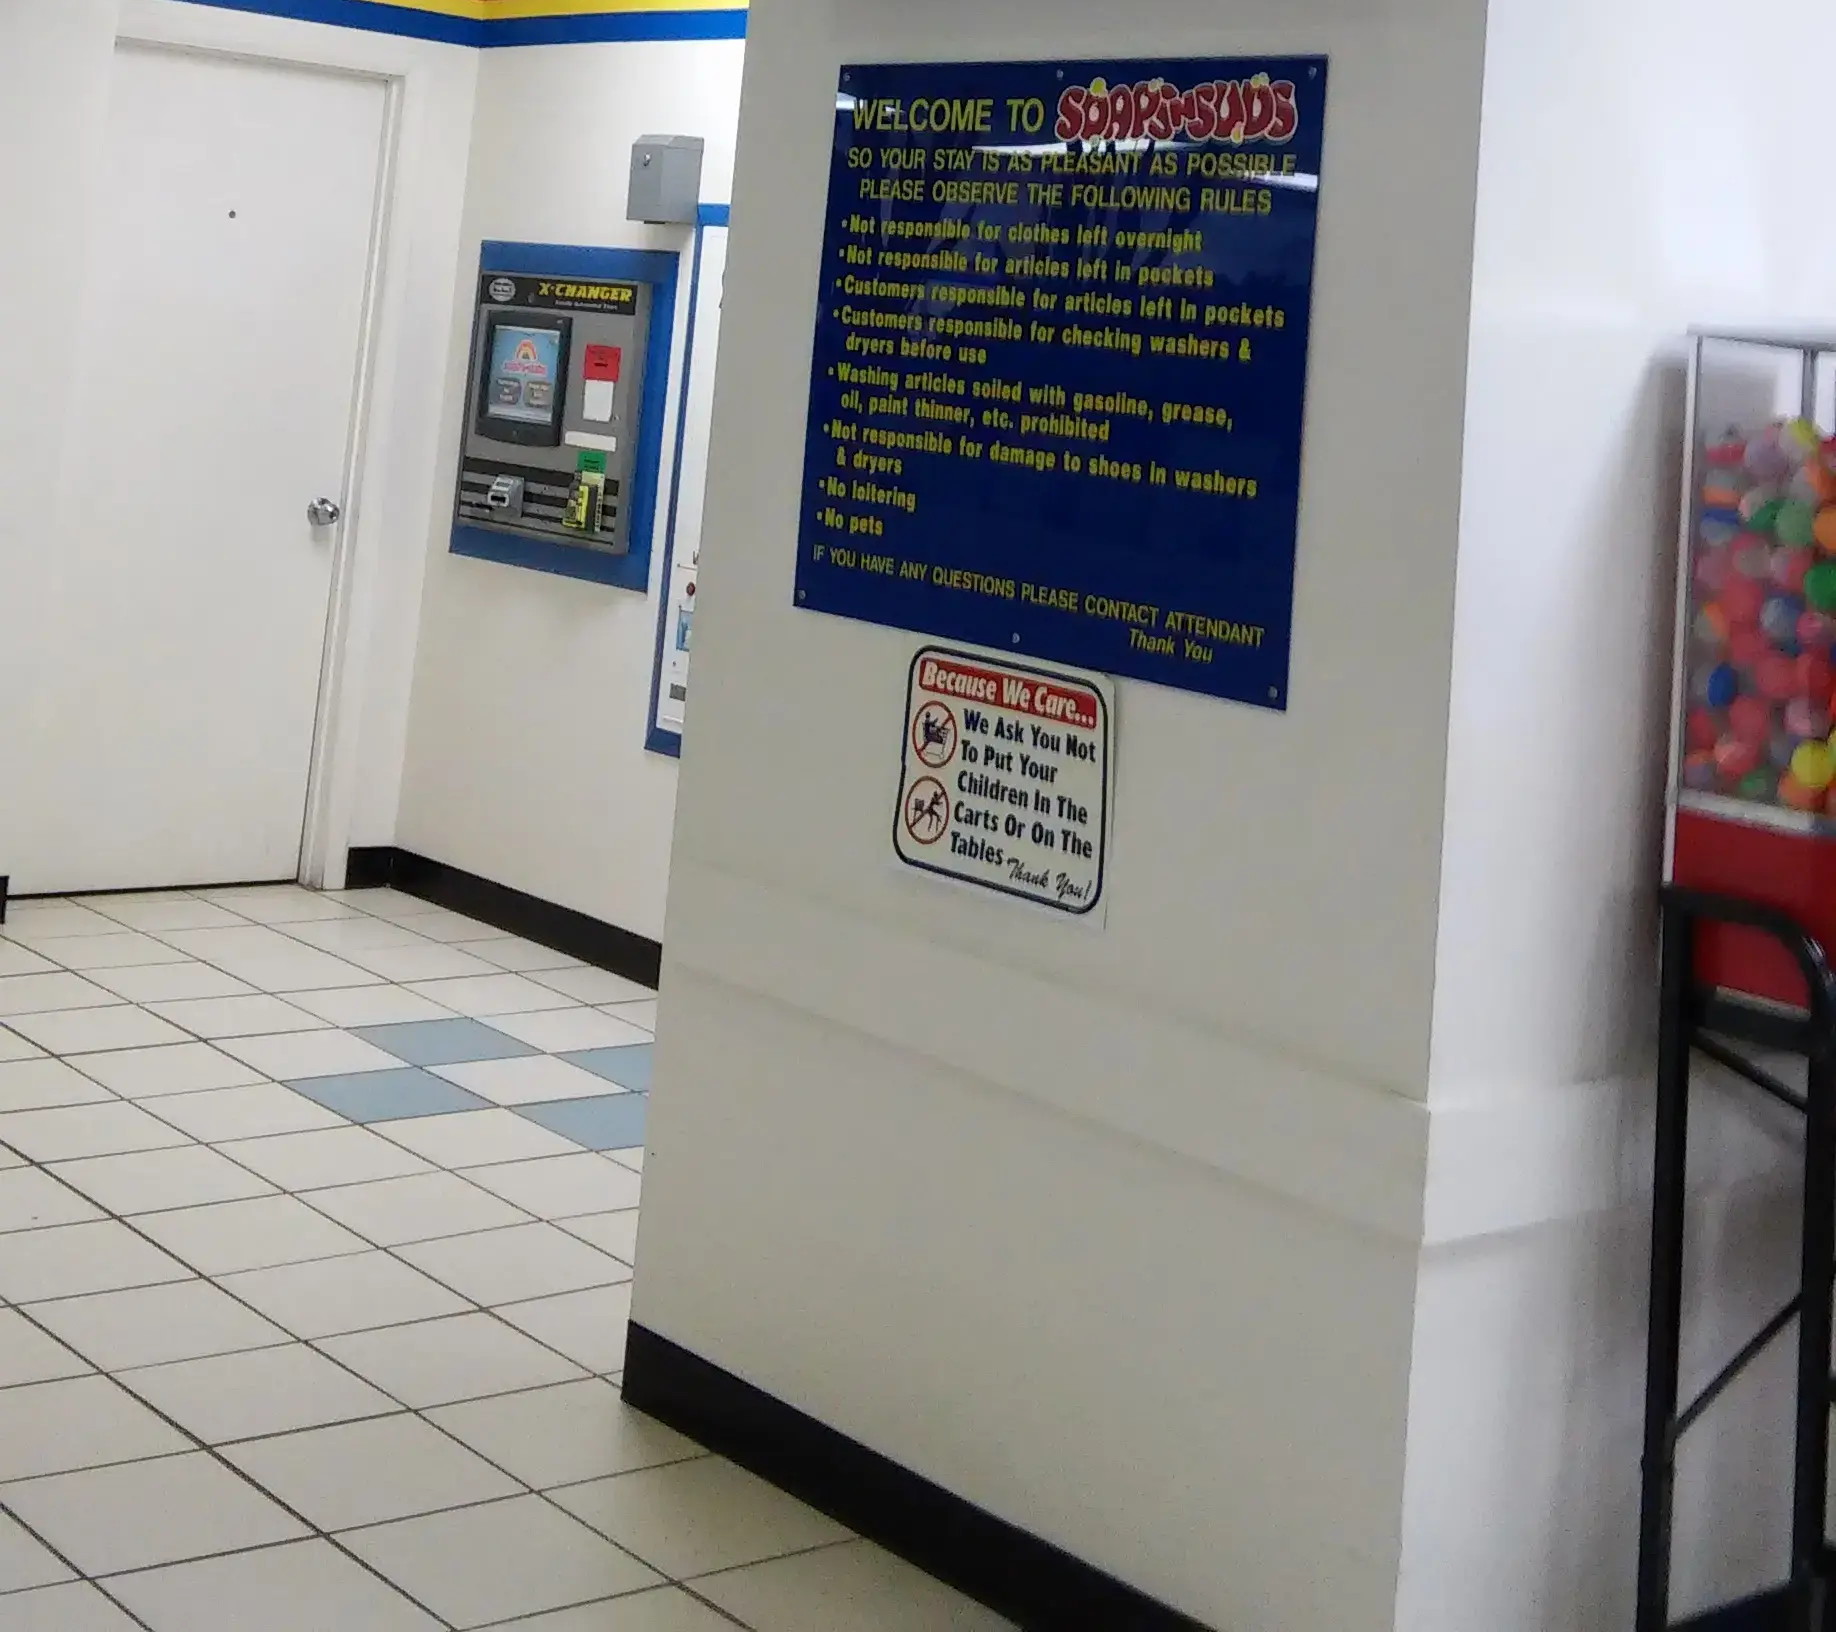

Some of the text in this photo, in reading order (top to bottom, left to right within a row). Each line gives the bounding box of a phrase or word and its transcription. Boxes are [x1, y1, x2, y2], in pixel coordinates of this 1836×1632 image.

[853, 98, 994, 133] WELCOME
[1006, 97, 1045, 133] TO
[847, 146, 1298, 179] SO YOUR STAY IS AS PLEASANT AS POSSIBLE
[859, 178, 1273, 216] PLEASE OBSERVE THE FOLLOWING RULES
[849, 214, 1203, 256] Not responsible for clothes left overnight
[846, 244, 1214, 287] Not responsible for articles left in pockets
[844, 274, 1285, 328] Customers responsible for articles left in pockets
[841, 305, 1252, 362] Customers responsible for checking washers &
[845, 332, 987, 364] dryers before use
[837, 361, 1233, 433] Washing articles soiled with gasoline, grease,
[841, 389, 1110, 442] oil, paint thinner, etc. prohibited
[831, 418, 1258, 499] Not responsible for damage to shoes in washers
[836, 445, 903, 476] & dryers
[826, 476, 917, 513] No loitering
[824, 507, 884, 537] No pets
[813, 544, 1266, 649] IF YOU HAVE ANY QUESTIONS PLEASE CONTACT ATTENDANT
[1129, 627, 1214, 665] Thank You
[921, 660, 998, 702] Because
[1001, 677, 1031, 711] We
[963, 708, 1097, 763] We Ask You Not
[960, 739, 1059, 784] To Put Your
[957, 769, 1089, 825] Children In The
[953, 800, 1094, 860] Carts Or On The
[950, 831, 1004, 866] Tables
[1006, 856, 1050, 890] Thank
